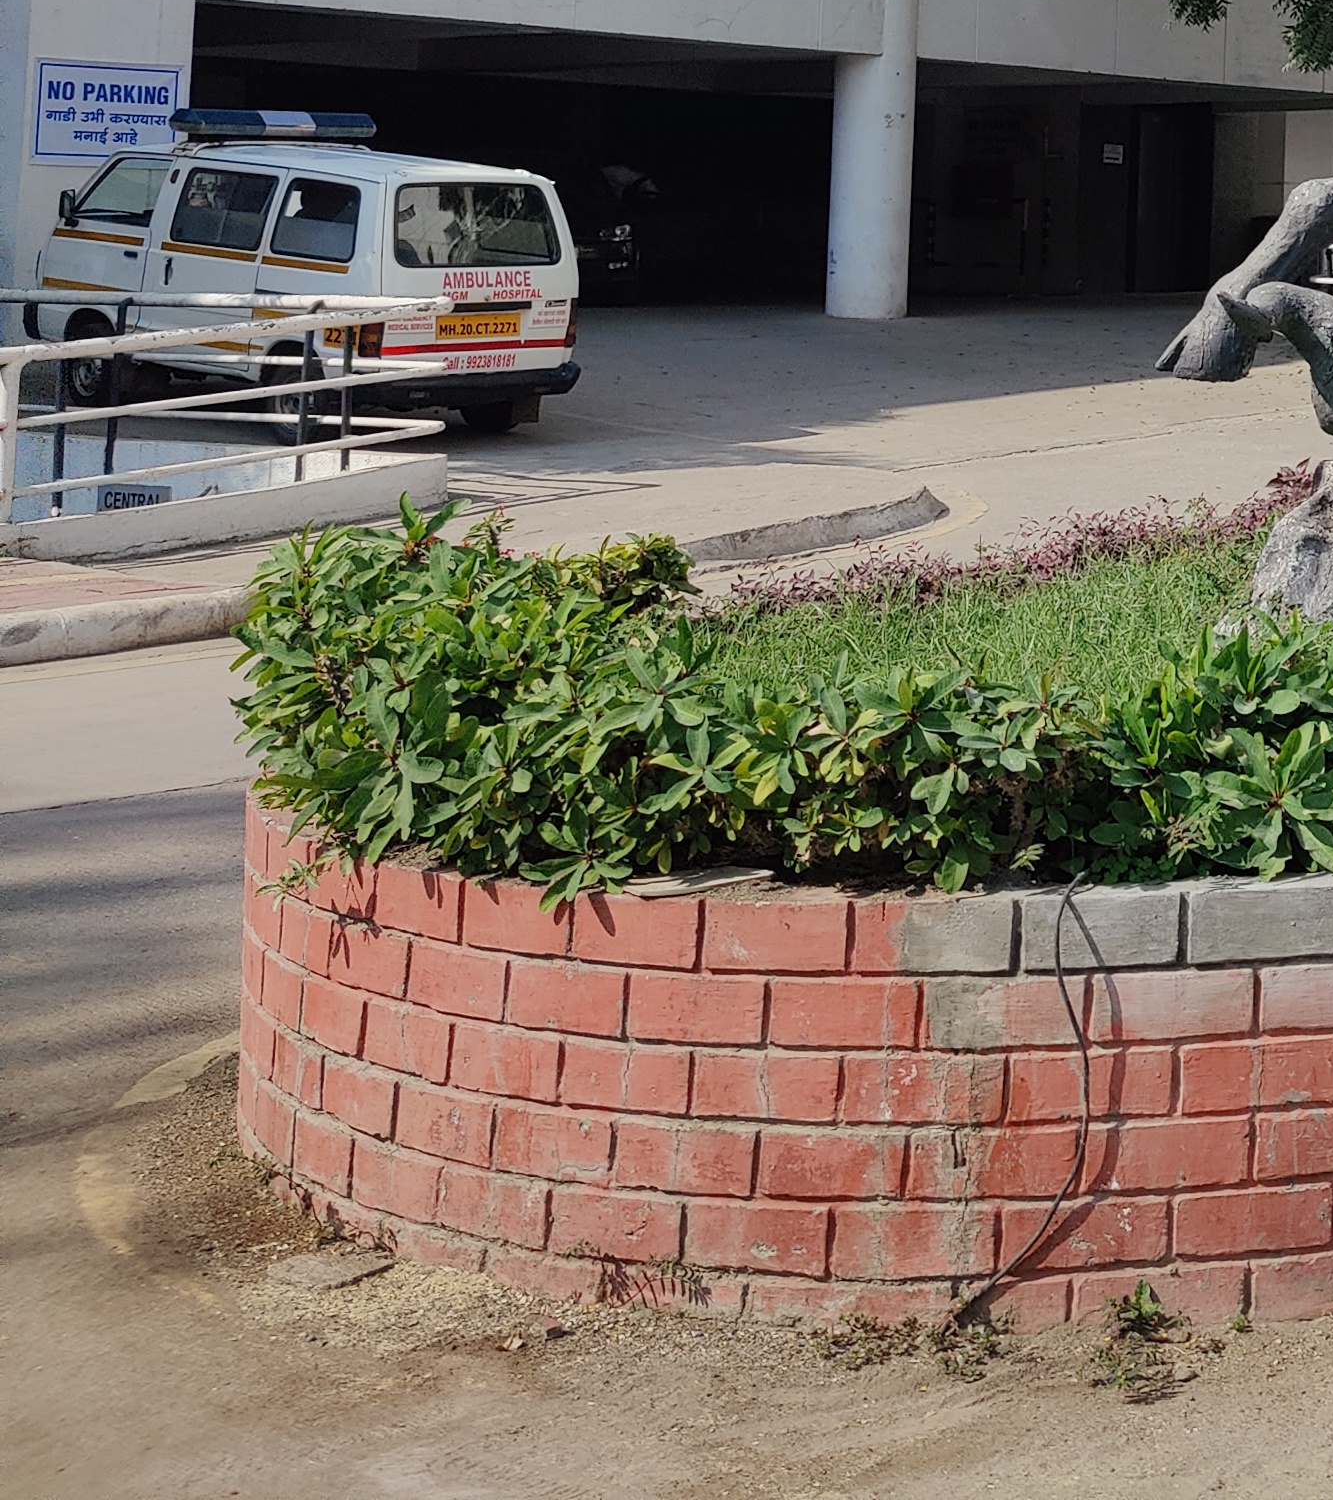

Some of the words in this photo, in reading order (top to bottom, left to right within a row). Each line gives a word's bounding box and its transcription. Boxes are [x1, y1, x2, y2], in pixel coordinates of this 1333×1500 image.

[47, 80, 75, 100] NO
[83, 82, 169, 105] PARKING
[45, 107, 76, 122] गाडी
[80, 108, 105, 123] उभी
[109, 112, 167, 126] करण्यास
[73, 127, 109, 145] मनाई
[112, 128, 138, 145] आहे
[443, 271, 531, 289] AMBULANCE
[493, 289, 542, 299] HOSPITAL
[325, 328, 357, 346] 221
[439, 321, 518, 336] MH.20.CT.2271
[466, 353, 517, 369] 9923818181
